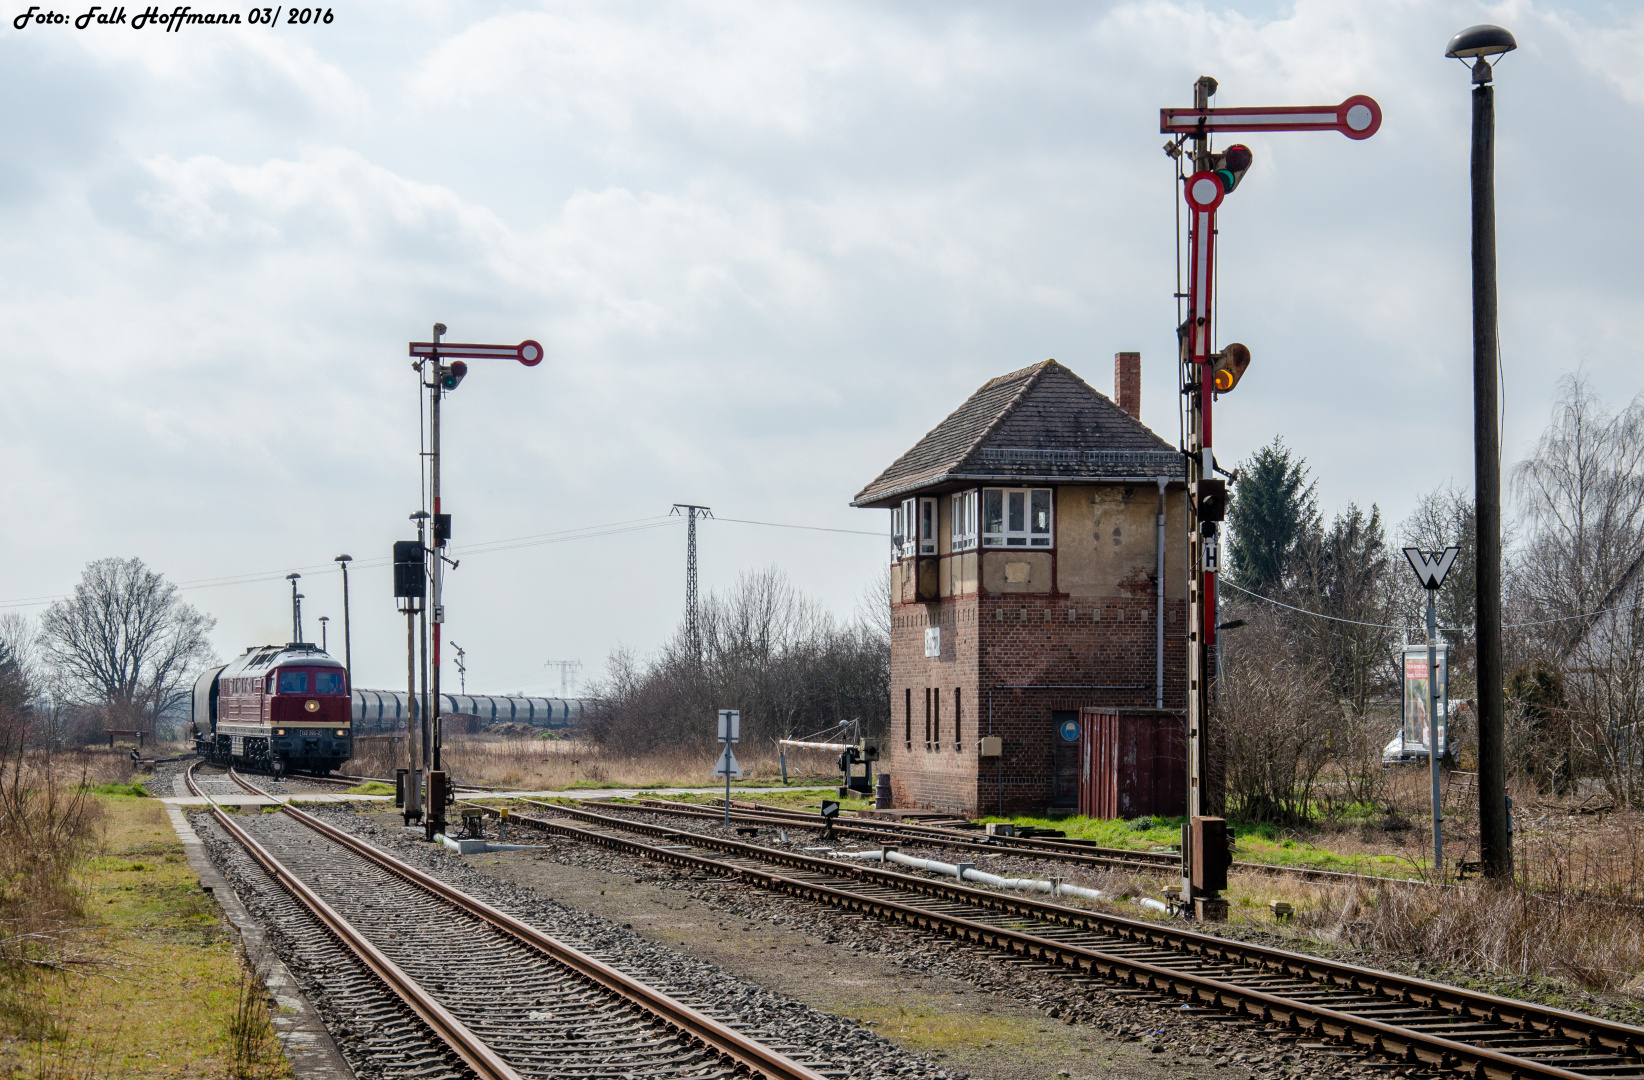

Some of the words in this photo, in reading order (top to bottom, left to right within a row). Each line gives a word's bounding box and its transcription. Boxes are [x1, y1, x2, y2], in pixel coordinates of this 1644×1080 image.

[1205, 547, 1217, 567] H
[1402, 547, 1461, 589] W
[434, 608, 442, 620] F
